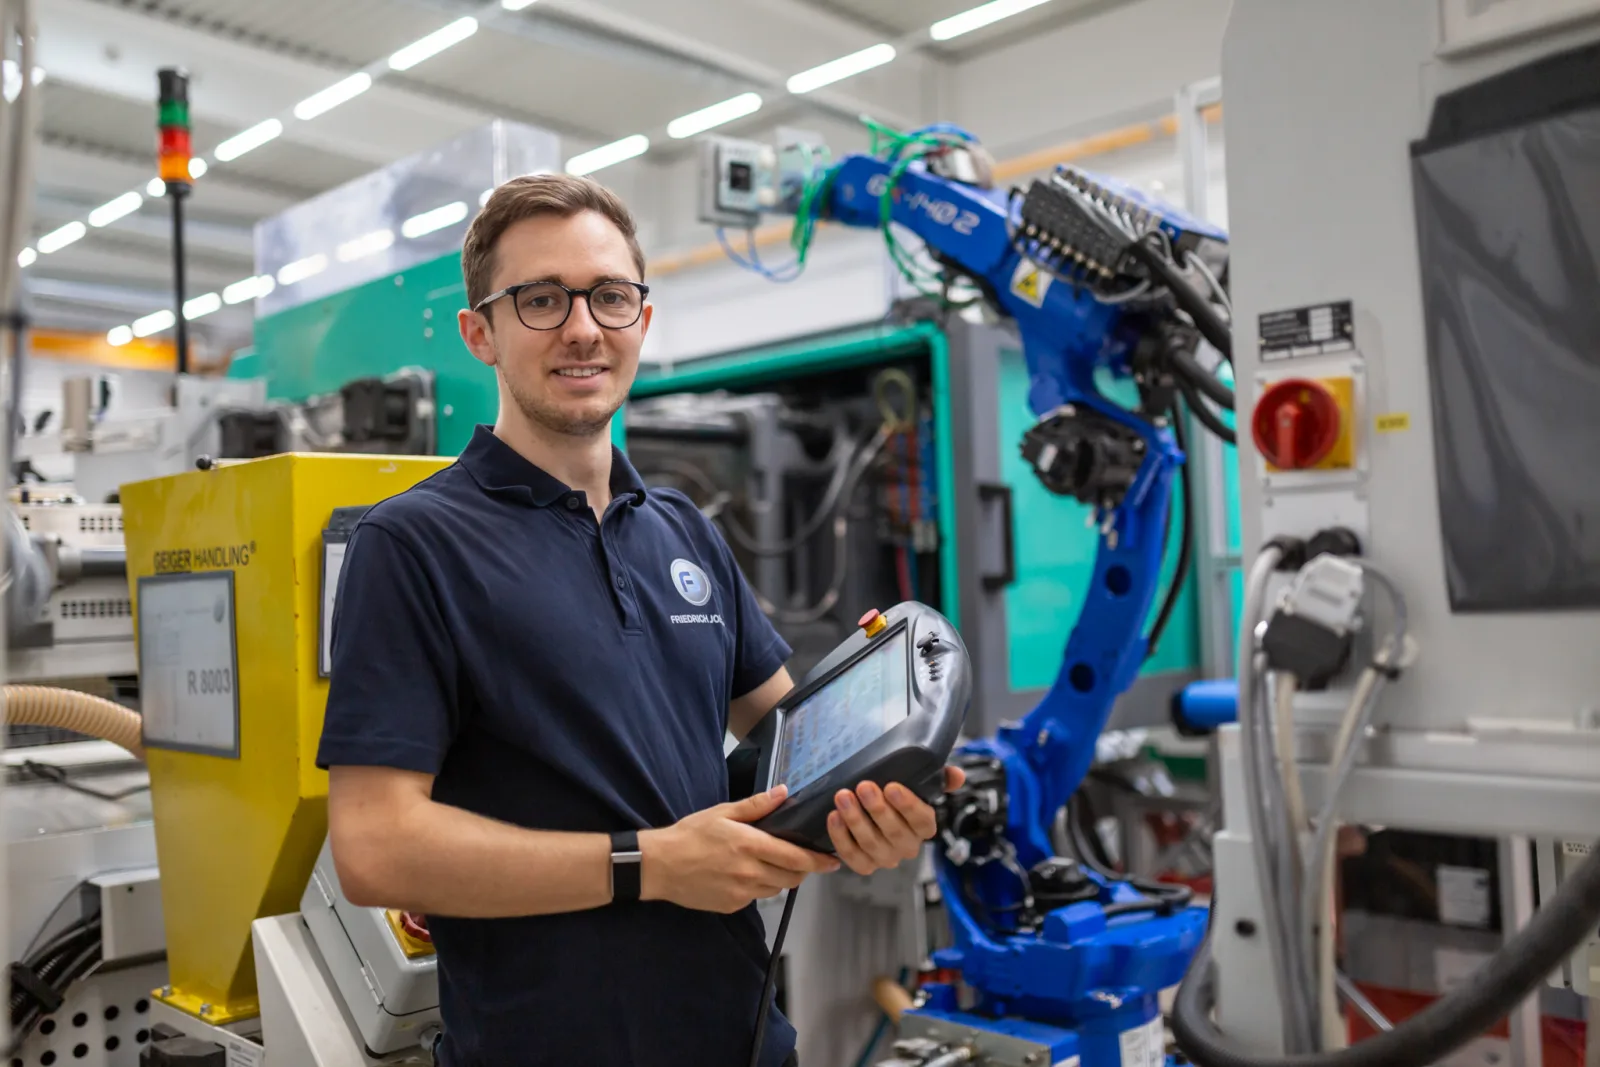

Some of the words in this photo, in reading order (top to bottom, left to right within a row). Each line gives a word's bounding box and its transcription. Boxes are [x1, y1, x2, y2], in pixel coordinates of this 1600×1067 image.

[153, 548, 191, 570] GEIGER
[670, 614, 708, 624] FRIEDRICH
[187, 670, 197, 695] R
[200, 668, 231, 695] 8003
